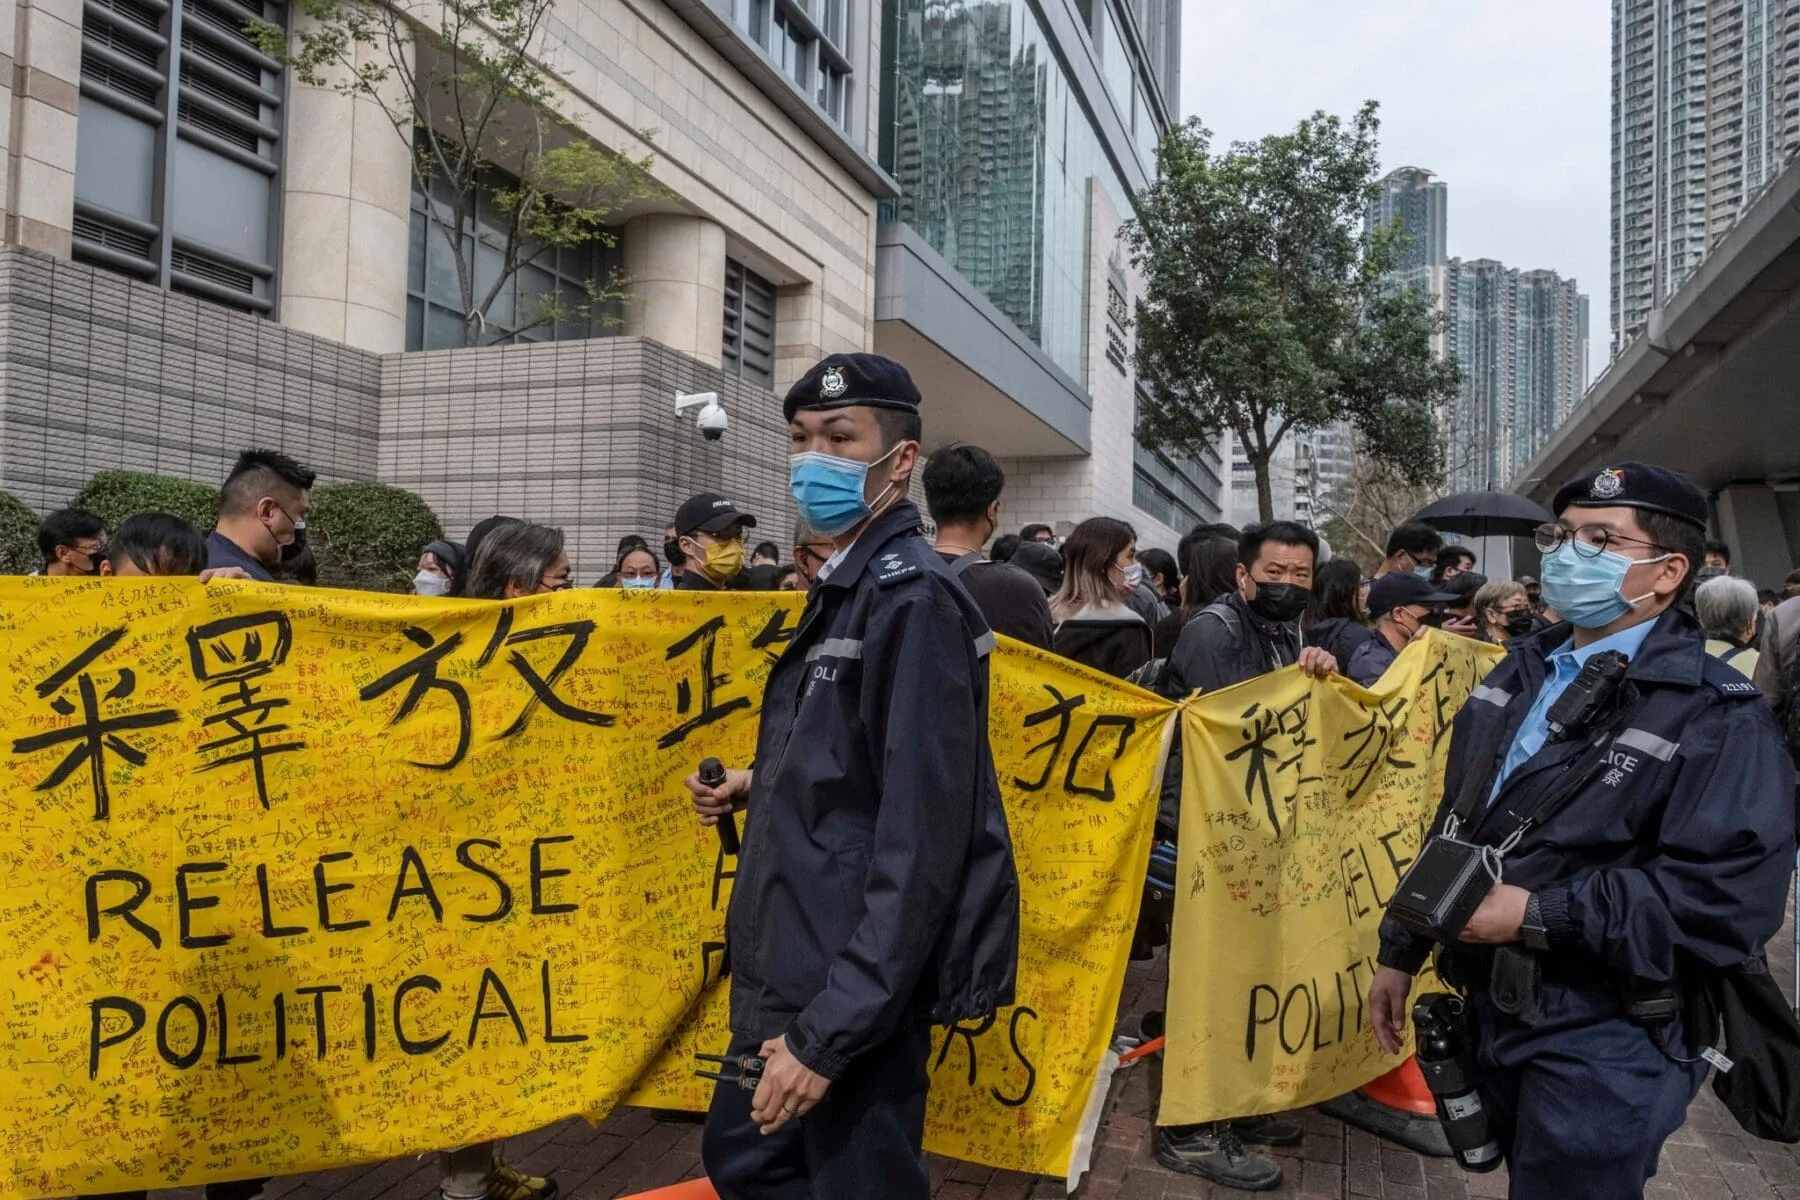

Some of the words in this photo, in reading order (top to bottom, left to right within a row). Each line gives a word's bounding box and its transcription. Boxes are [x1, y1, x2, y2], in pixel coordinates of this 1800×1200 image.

[814, 665, 837, 682] OLI
[1722, 682, 1755, 692] 22191
[1599, 750, 1638, 773] ICE
[1601, 768, 1624, 787] 察
[85, 834, 580, 948] RELEASE
[89, 958, 590, 1079] POLITICAL
[1245, 958, 1376, 1062] POLIT
